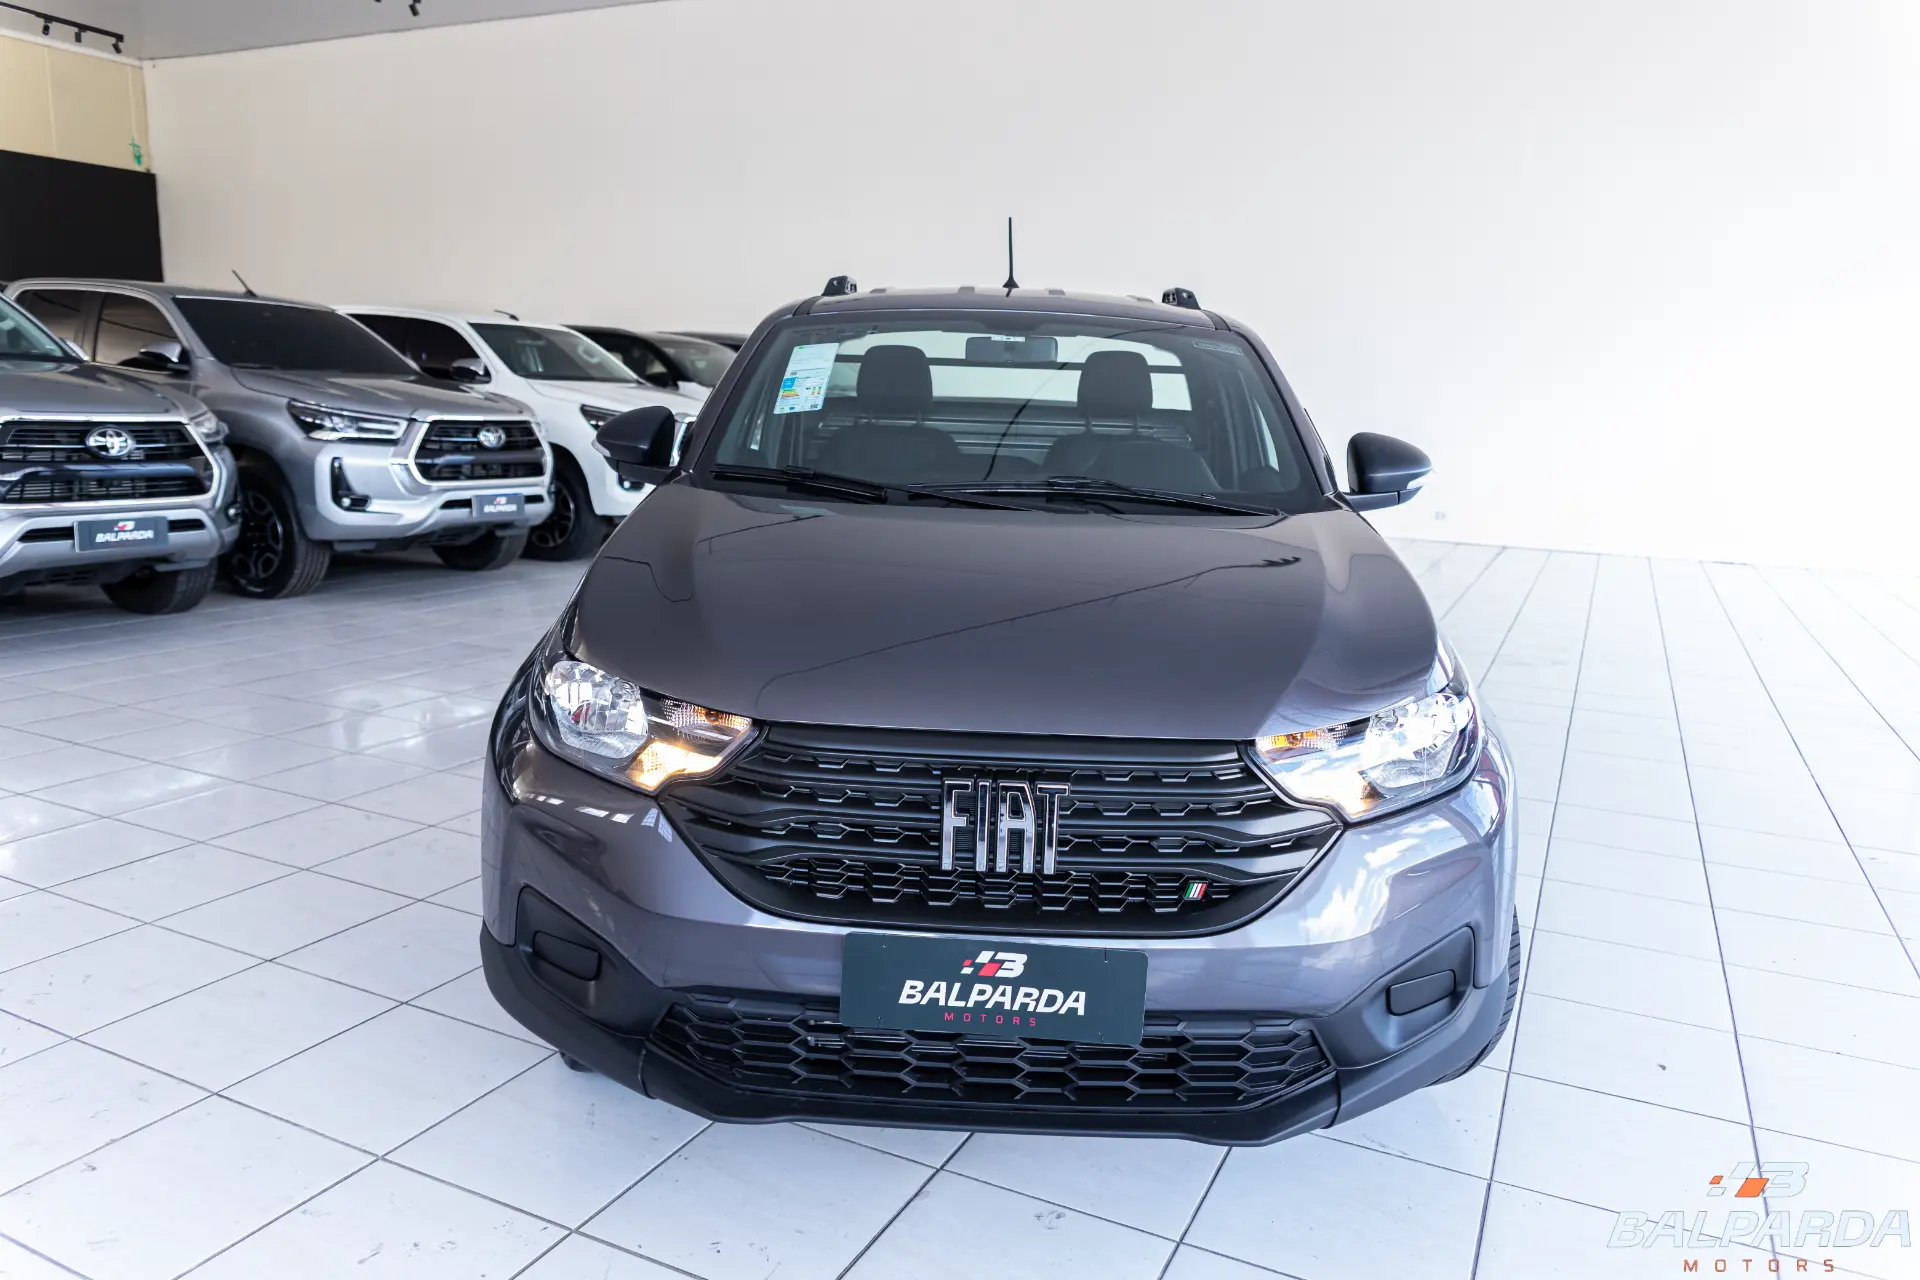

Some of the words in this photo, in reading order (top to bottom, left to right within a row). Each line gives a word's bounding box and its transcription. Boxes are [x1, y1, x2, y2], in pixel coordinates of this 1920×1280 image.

[941, 778, 1072, 876] FIAT
[898, 979, 1087, 1016] BALPARDA
[944, 1011, 1037, 1027] MOTORS
